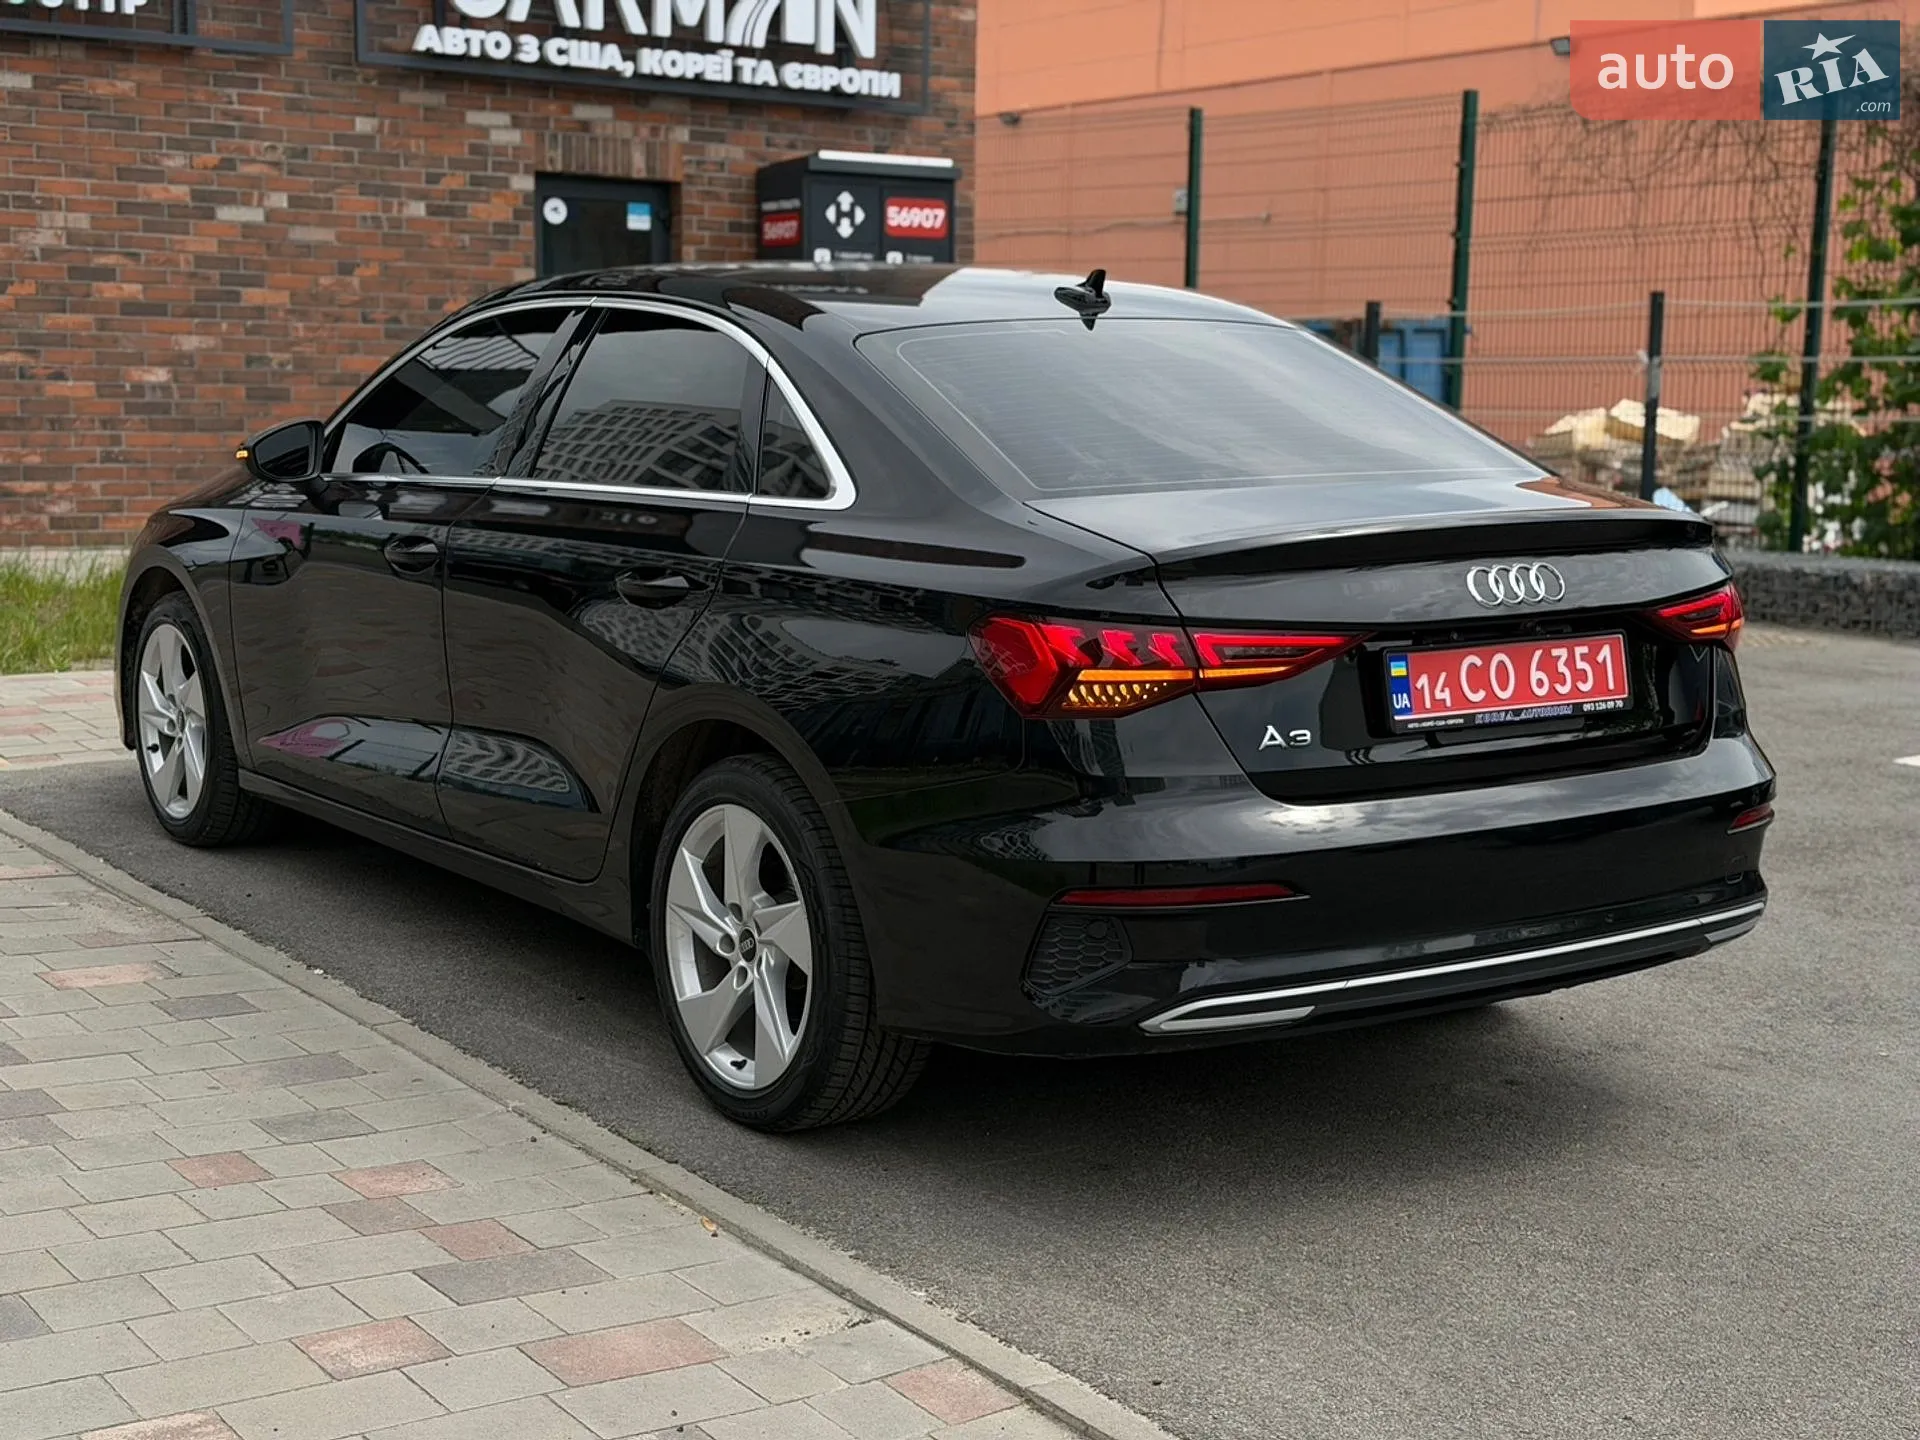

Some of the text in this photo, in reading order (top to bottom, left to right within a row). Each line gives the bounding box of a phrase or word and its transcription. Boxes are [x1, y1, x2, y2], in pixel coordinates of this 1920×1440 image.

[412, 24, 901, 98] АВТО З США, КОРЕЇ ТА ЄВРОПИ
[886, 205, 946, 229] 56907
[1415, 644, 1616, 709] 14 CO 6351
[1392, 692, 1411, 709] UA
[1258, 725, 1311, 751] A3
